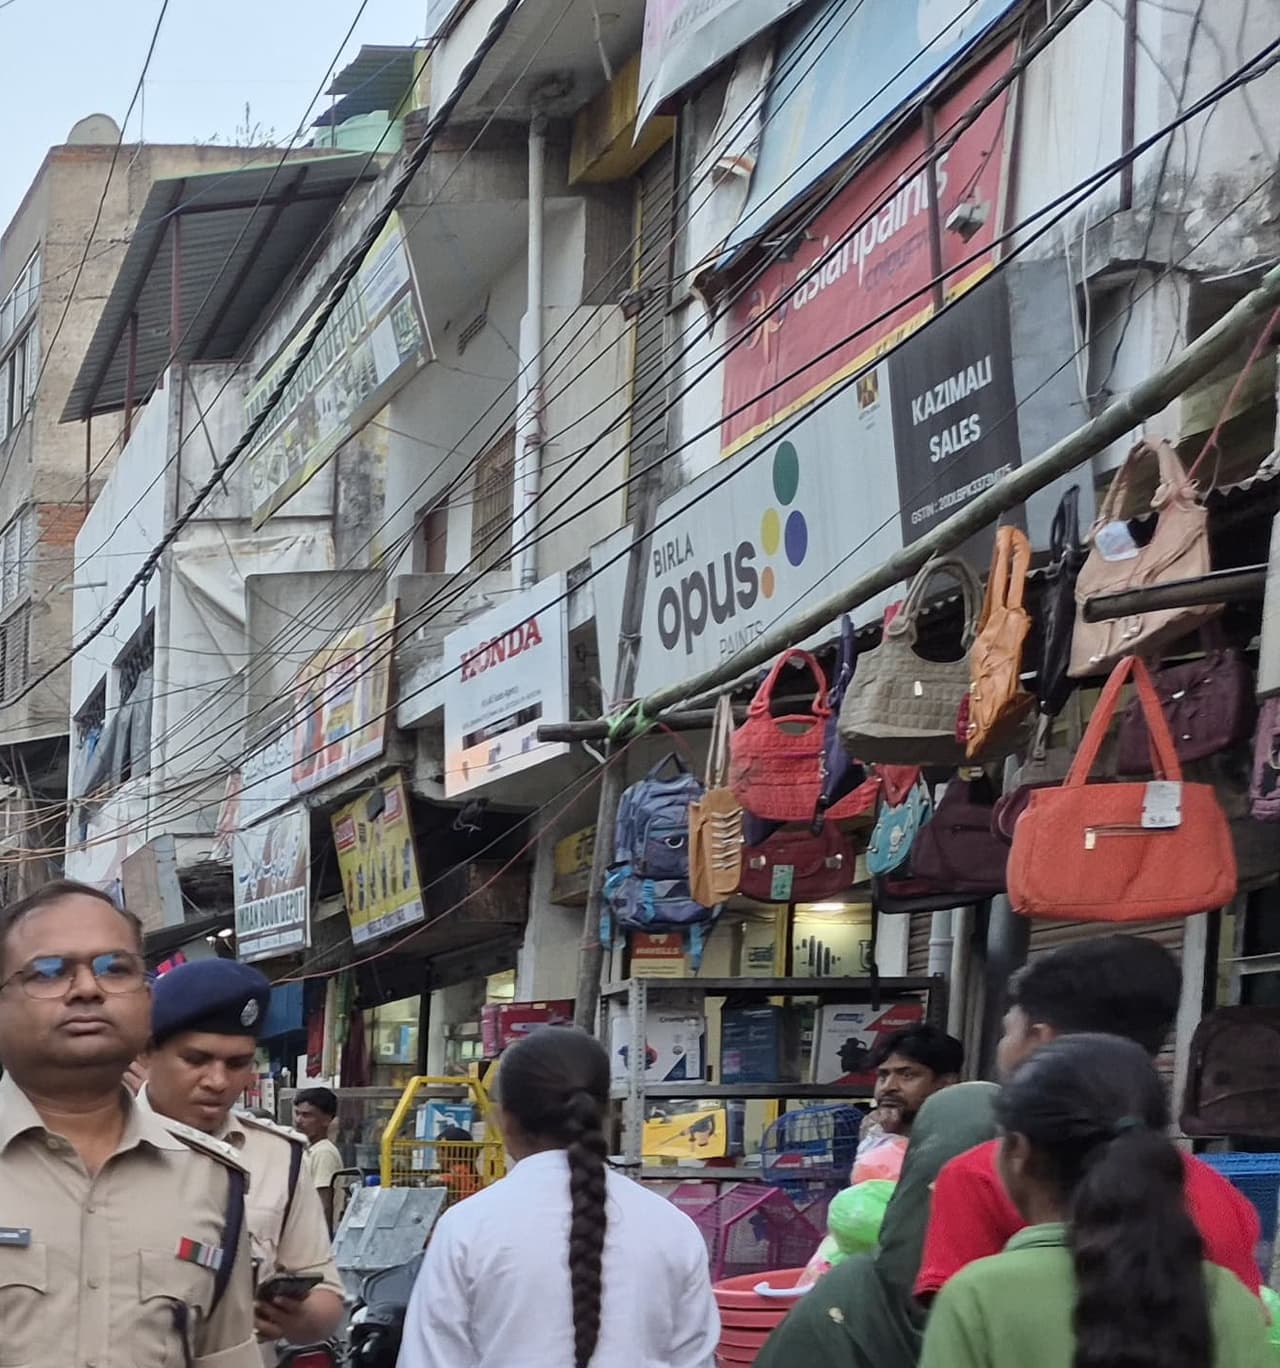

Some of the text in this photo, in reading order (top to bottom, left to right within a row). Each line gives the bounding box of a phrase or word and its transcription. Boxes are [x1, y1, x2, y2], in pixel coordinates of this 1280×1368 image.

[911, 355, 993, 426] KAZIMALI
[929, 413, 981, 463] SALES
[652, 531, 694, 579] BIRLA
[657, 540, 759, 656] opus
[459, 616, 543, 684] HONDA
